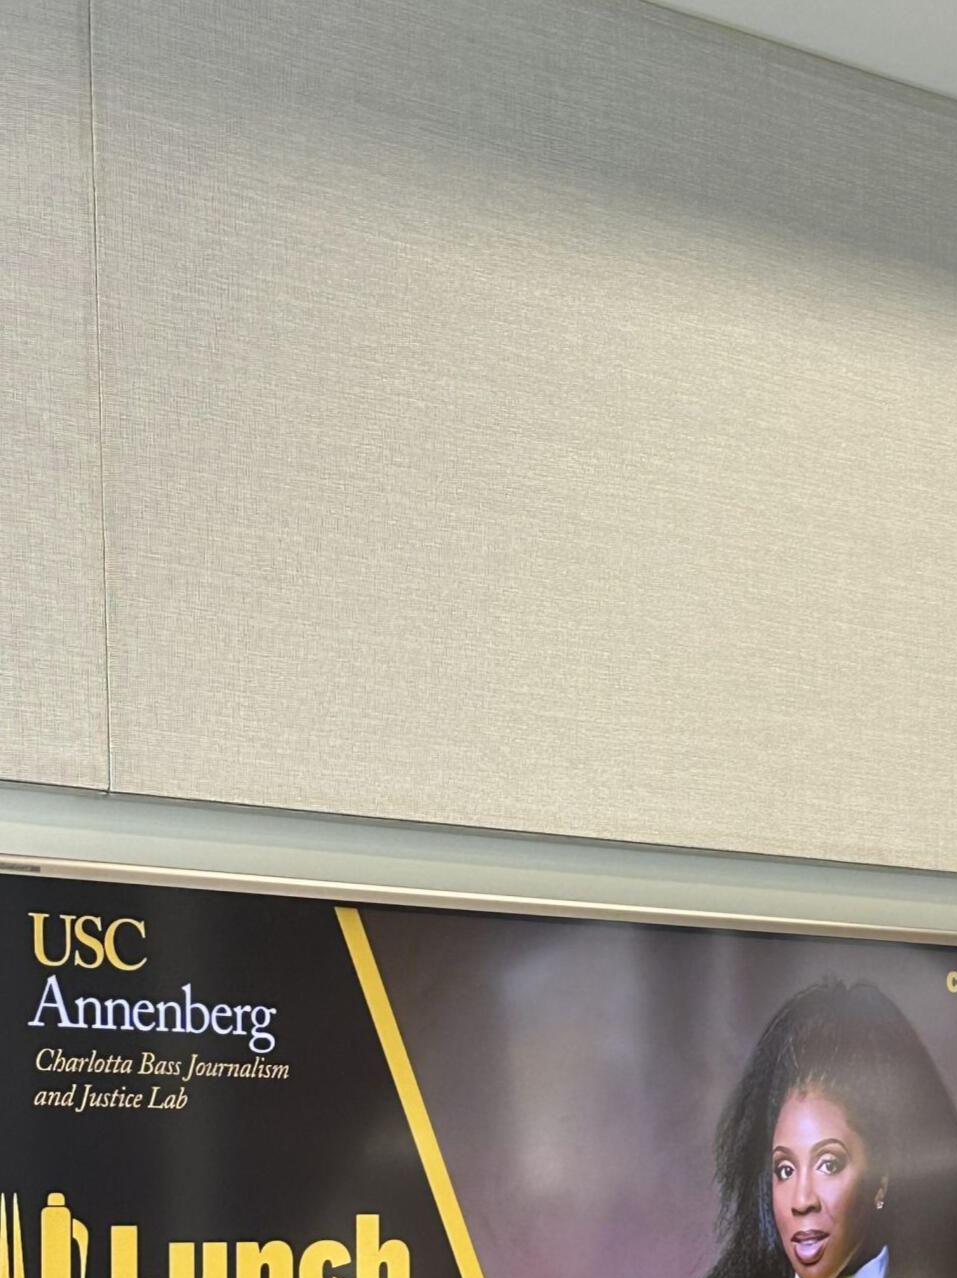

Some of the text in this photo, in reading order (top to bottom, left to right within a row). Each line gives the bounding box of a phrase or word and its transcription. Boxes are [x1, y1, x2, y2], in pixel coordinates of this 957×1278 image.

[28, 912, 148, 971] USC
[28, 975, 277, 1053] Annenberg
[35, 1048, 290, 1081] Charlotta Bass Journalism
[34, 1084, 189, 1113] and Justice Lab
